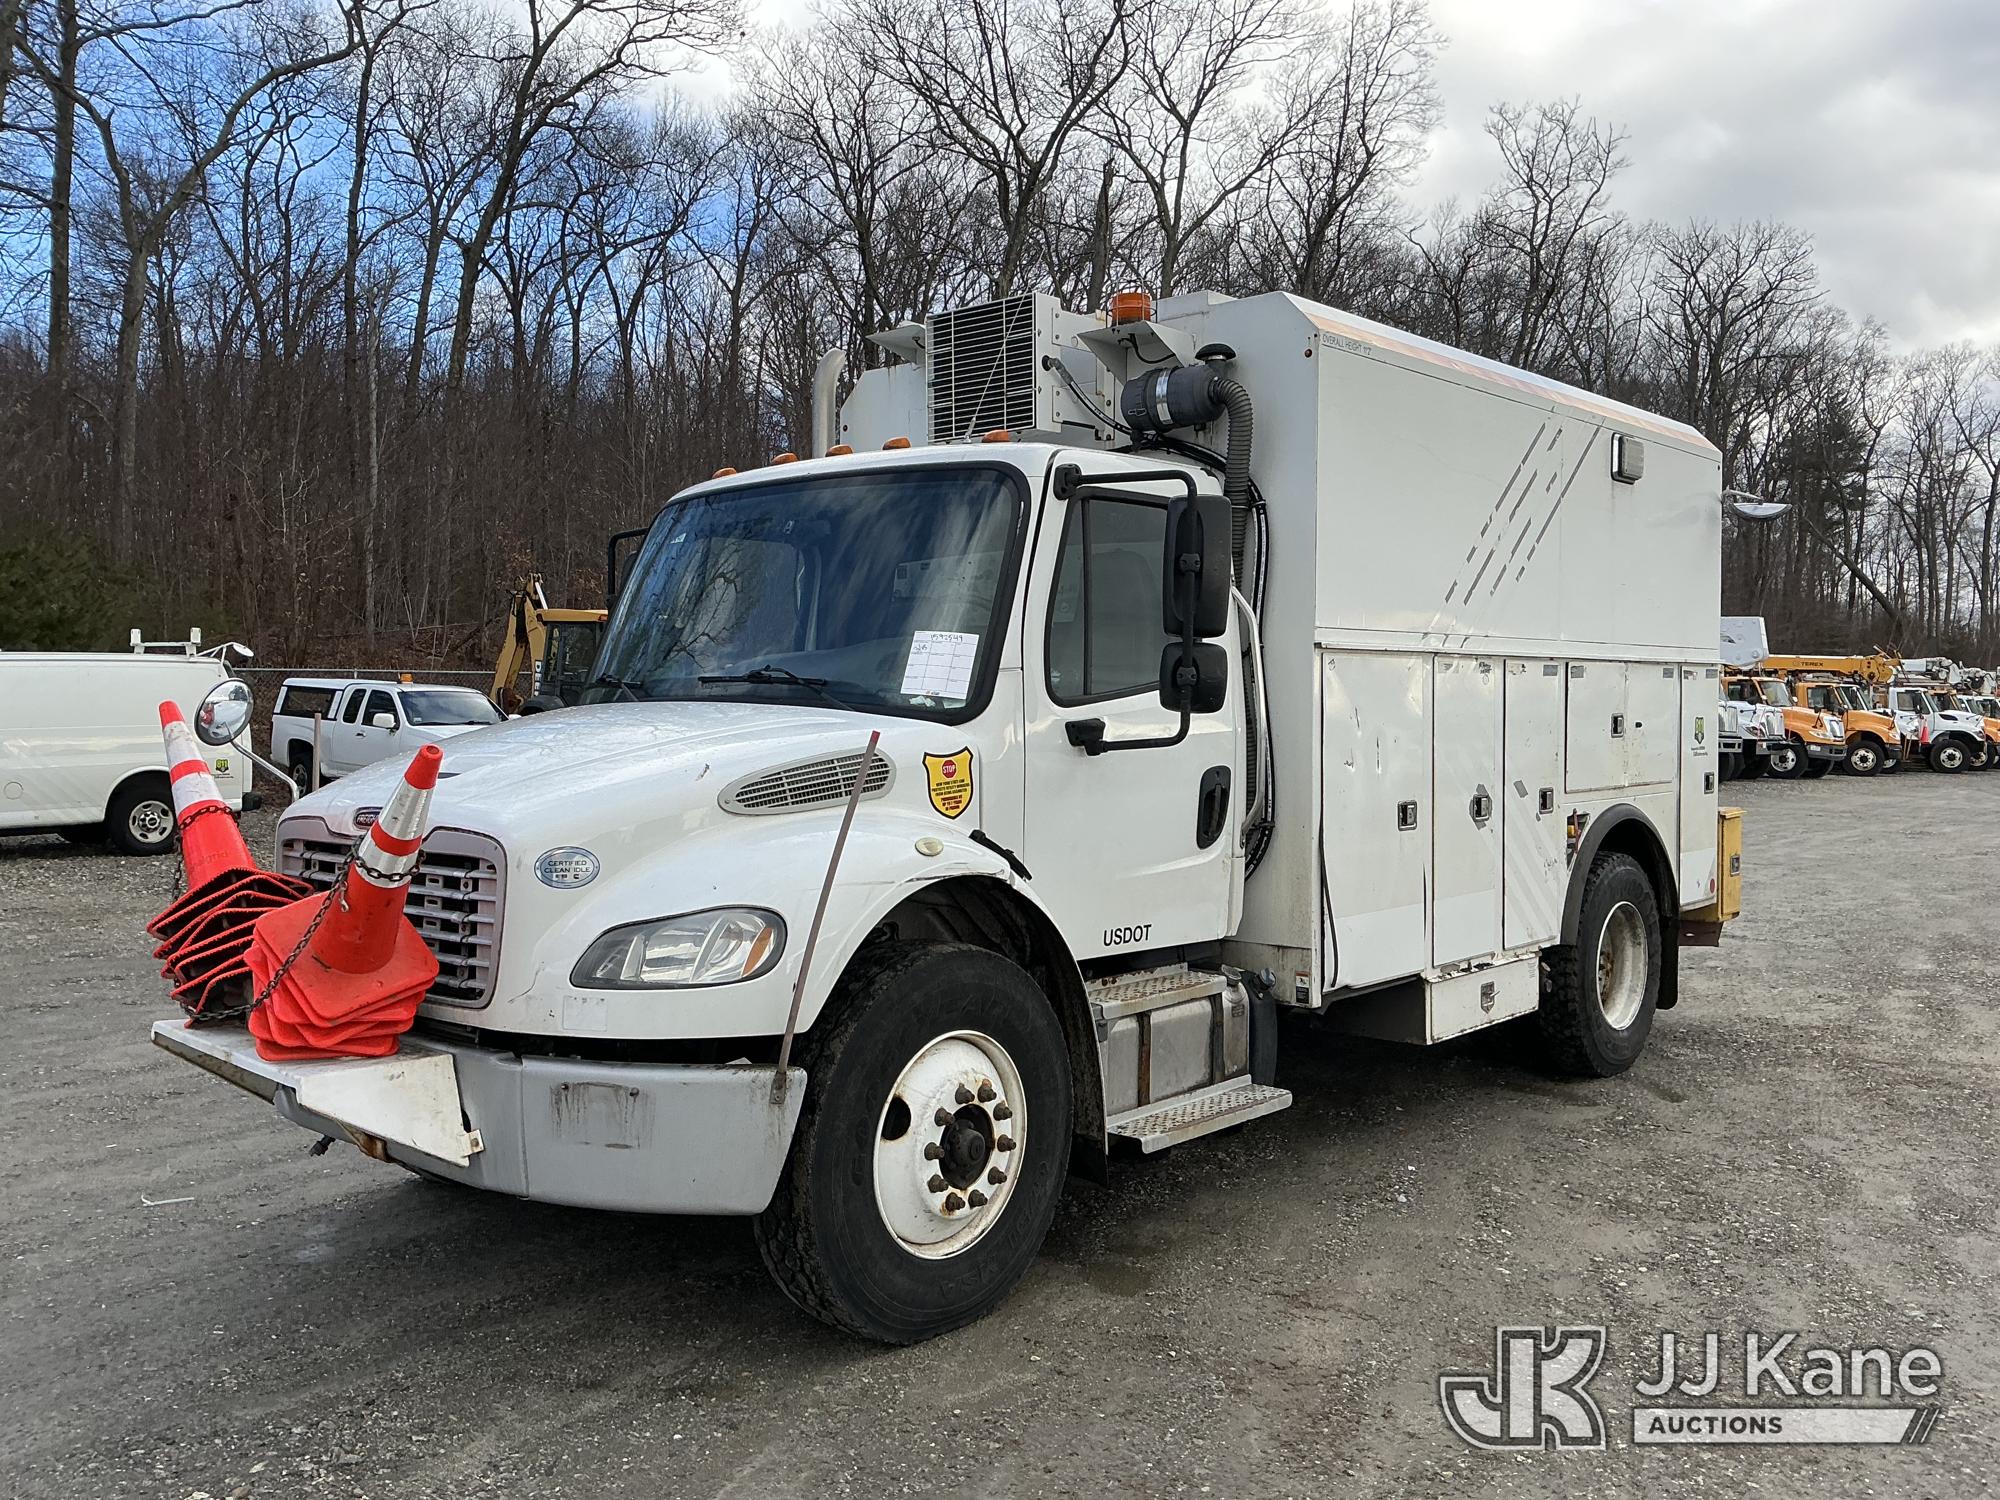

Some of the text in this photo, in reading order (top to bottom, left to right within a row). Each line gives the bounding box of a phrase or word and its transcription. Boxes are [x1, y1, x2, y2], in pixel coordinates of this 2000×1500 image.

[1322, 334, 1344, 348] OVERALL
[943, 764, 956, 773] STOP
[1103, 924, 1152, 947] USDOT
